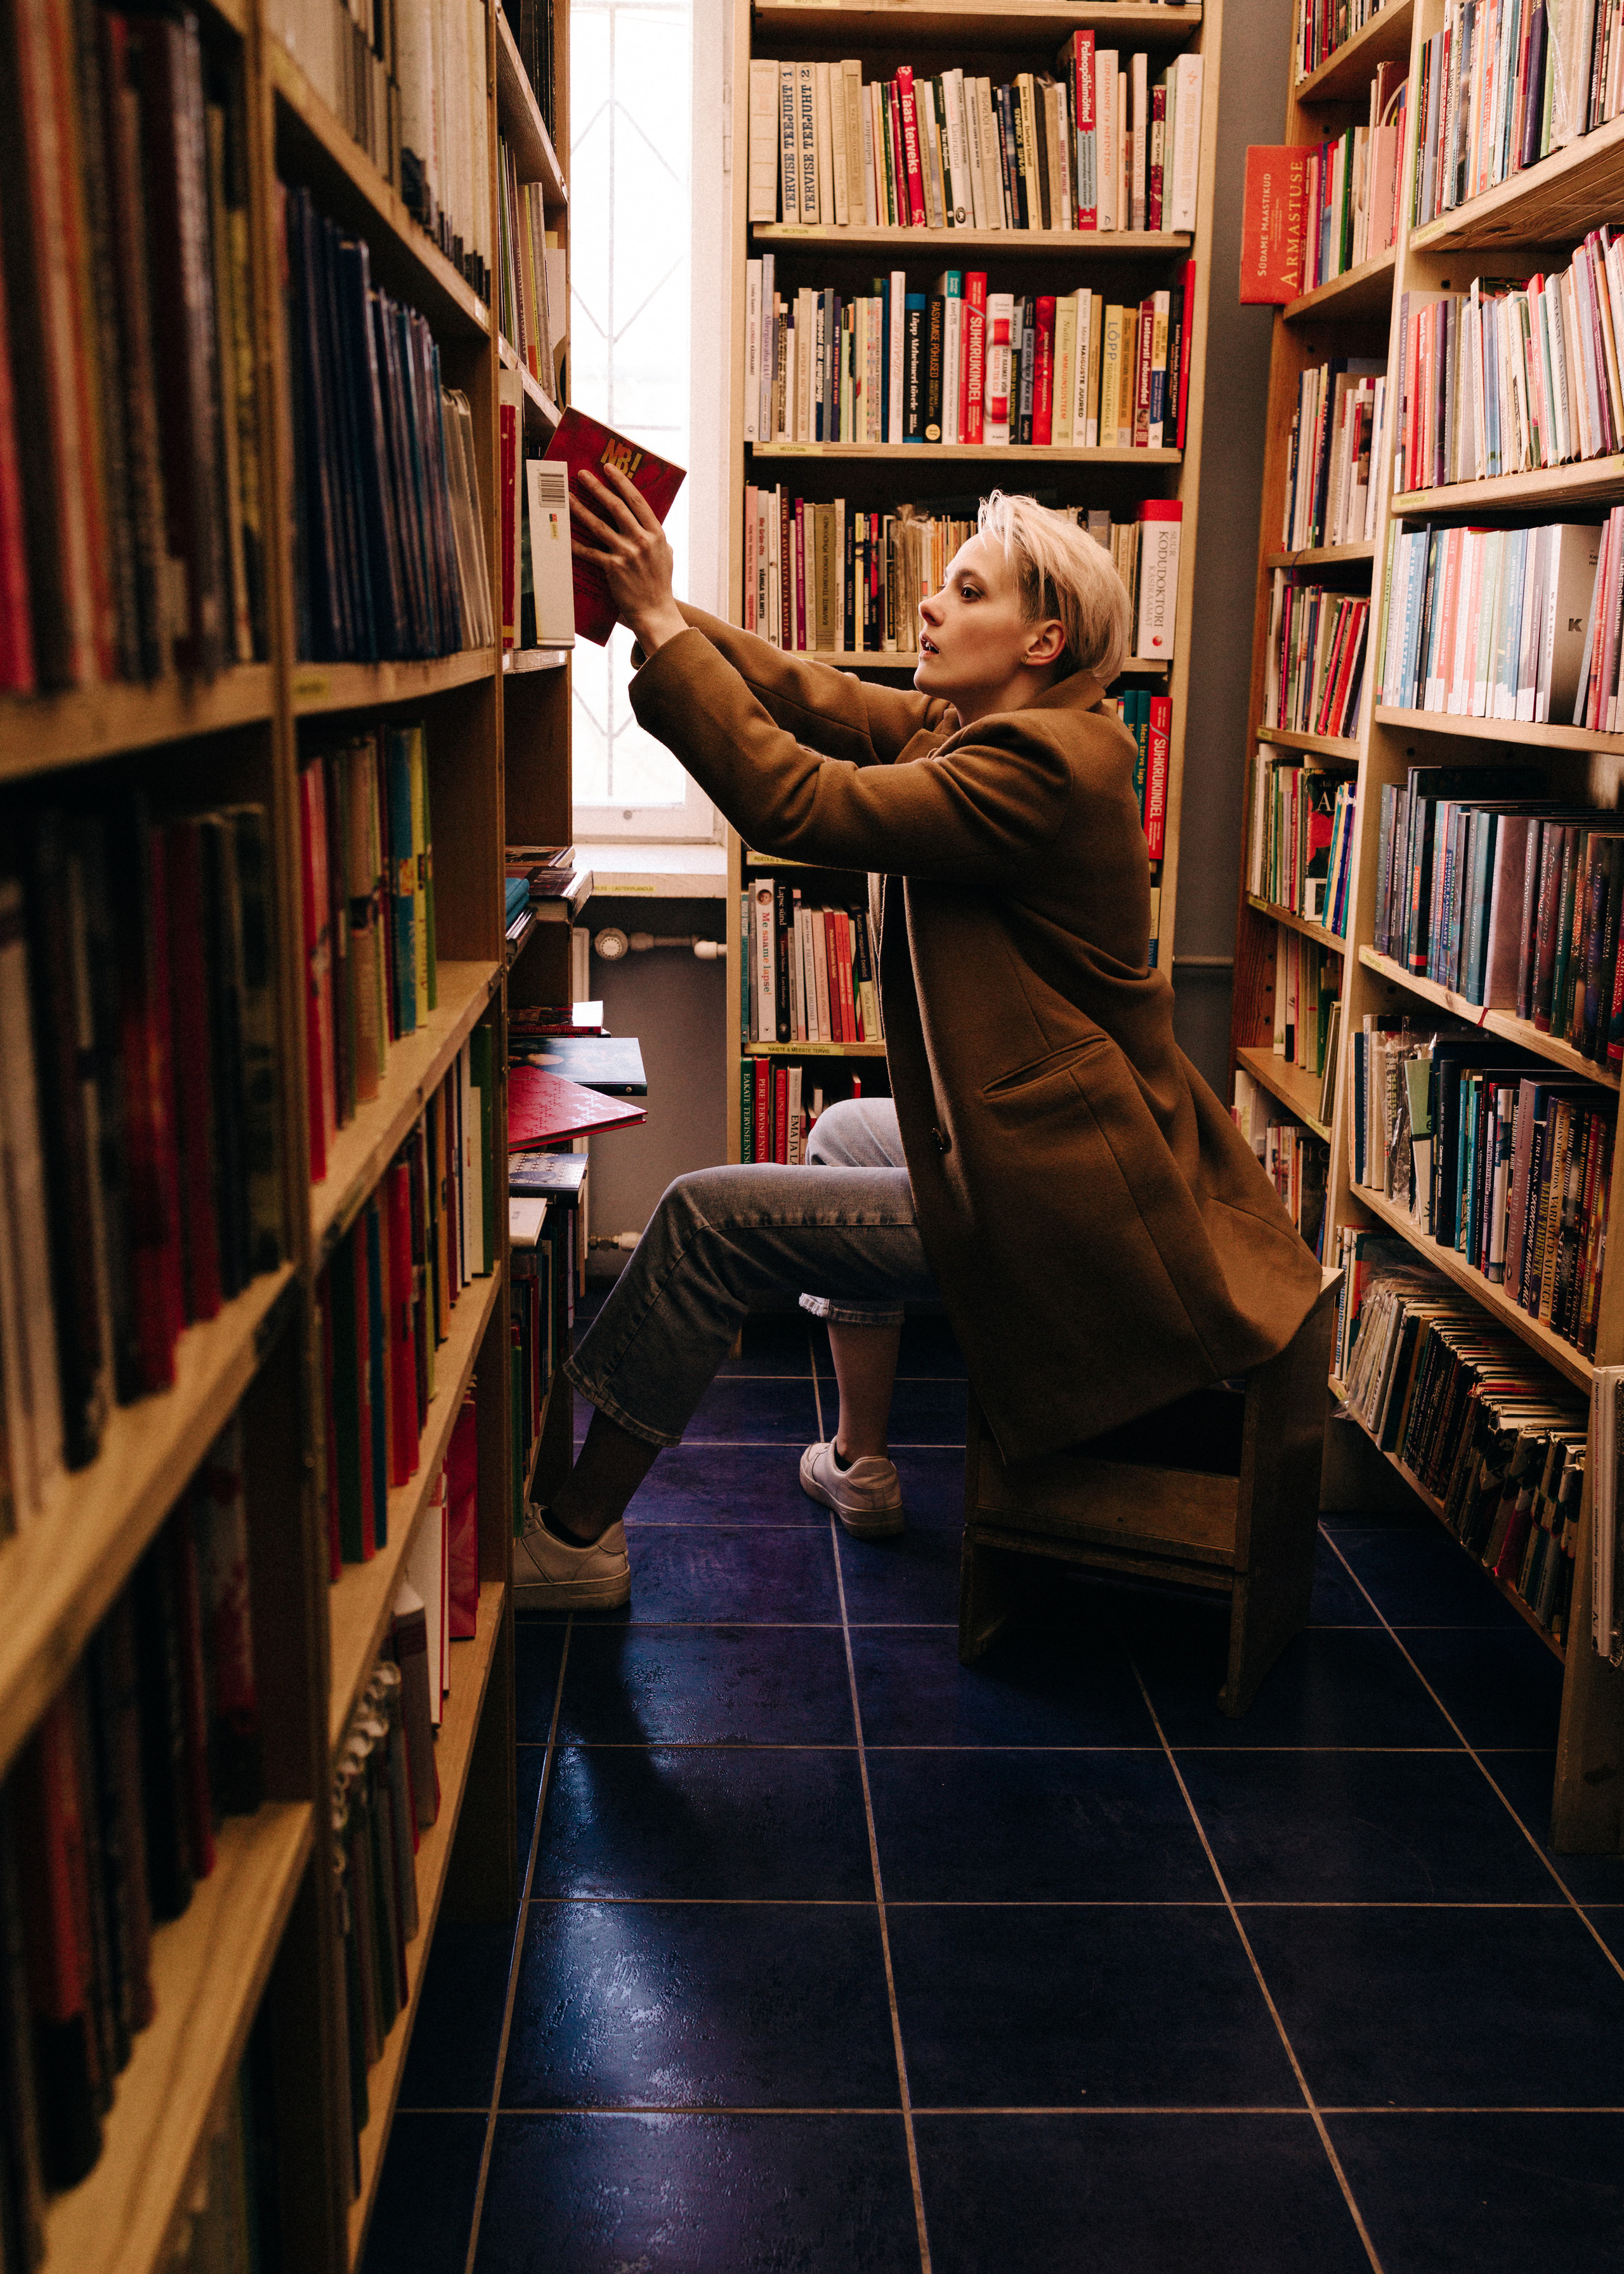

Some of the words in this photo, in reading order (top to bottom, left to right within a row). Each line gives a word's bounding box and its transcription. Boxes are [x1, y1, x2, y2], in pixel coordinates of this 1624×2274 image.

[1080, 41, 1092, 123] Paleopõhimõtted
[783, 85, 794, 149] TEEJUHT
[802, 85, 813, 149] TEEJUHT
[901, 93, 913, 123] Taas
[905, 128, 918, 174] terveks
[785, 154, 796, 210] TERVISE
[805, 154, 815, 211] TERVISE
[1261, 173, 1271, 231] MAASTIKUD
[1280, 161, 1303, 287] ARMASTUSE
[1257, 231, 1269, 277] SÜDAME
[909, 338, 919, 383] Alzheimeri
[968, 317, 982, 402] SUHKRUKINDEL
[1107, 322, 1120, 360] LÕPP
[1143, 317, 1152, 359] Lastearsti
[910, 385, 919, 411] tõvele
[1141, 360, 1149, 405] nõuanded
[600, 438, 643, 479] NB!
[1146, 566, 1155, 627] KÄSIRAAMAT
[1155, 532, 1169, 627] KODUDOKTORI
[1444, 564, 1453, 617] SÕLTUVUSTEST
[1483, 580, 1492, 624] AUTISMI
[1402, 622, 1411, 674] MEETOD
[1439, 622, 1448, 666] VABANEMINE
[1547, 591, 1555, 659] KAINUS
[1568, 618, 1583, 633] K
[1150, 739, 1166, 818] SUHKRUKINDEL
[762, 912, 770, 928] Me
[778, 886, 786, 906] Lapse
[1557, 877, 1568, 955] TRANSPERSONAALNE
[762, 966, 771, 996] lapse!
[789, 1140, 798, 1152] JA
[790, 1115, 799, 1138] EMA
[1511, 1156, 1523, 1214] JUMALATE
[1553, 1143, 1562, 1190] HAUGHTON
[1507, 1218, 1518, 1258] JÄLJED
[1526, 1191, 1538, 1245] SKORPIONI
[1545, 1195, 1559, 1254] VARJATUD
[1542, 1257, 1554, 1309] AJALUGU
